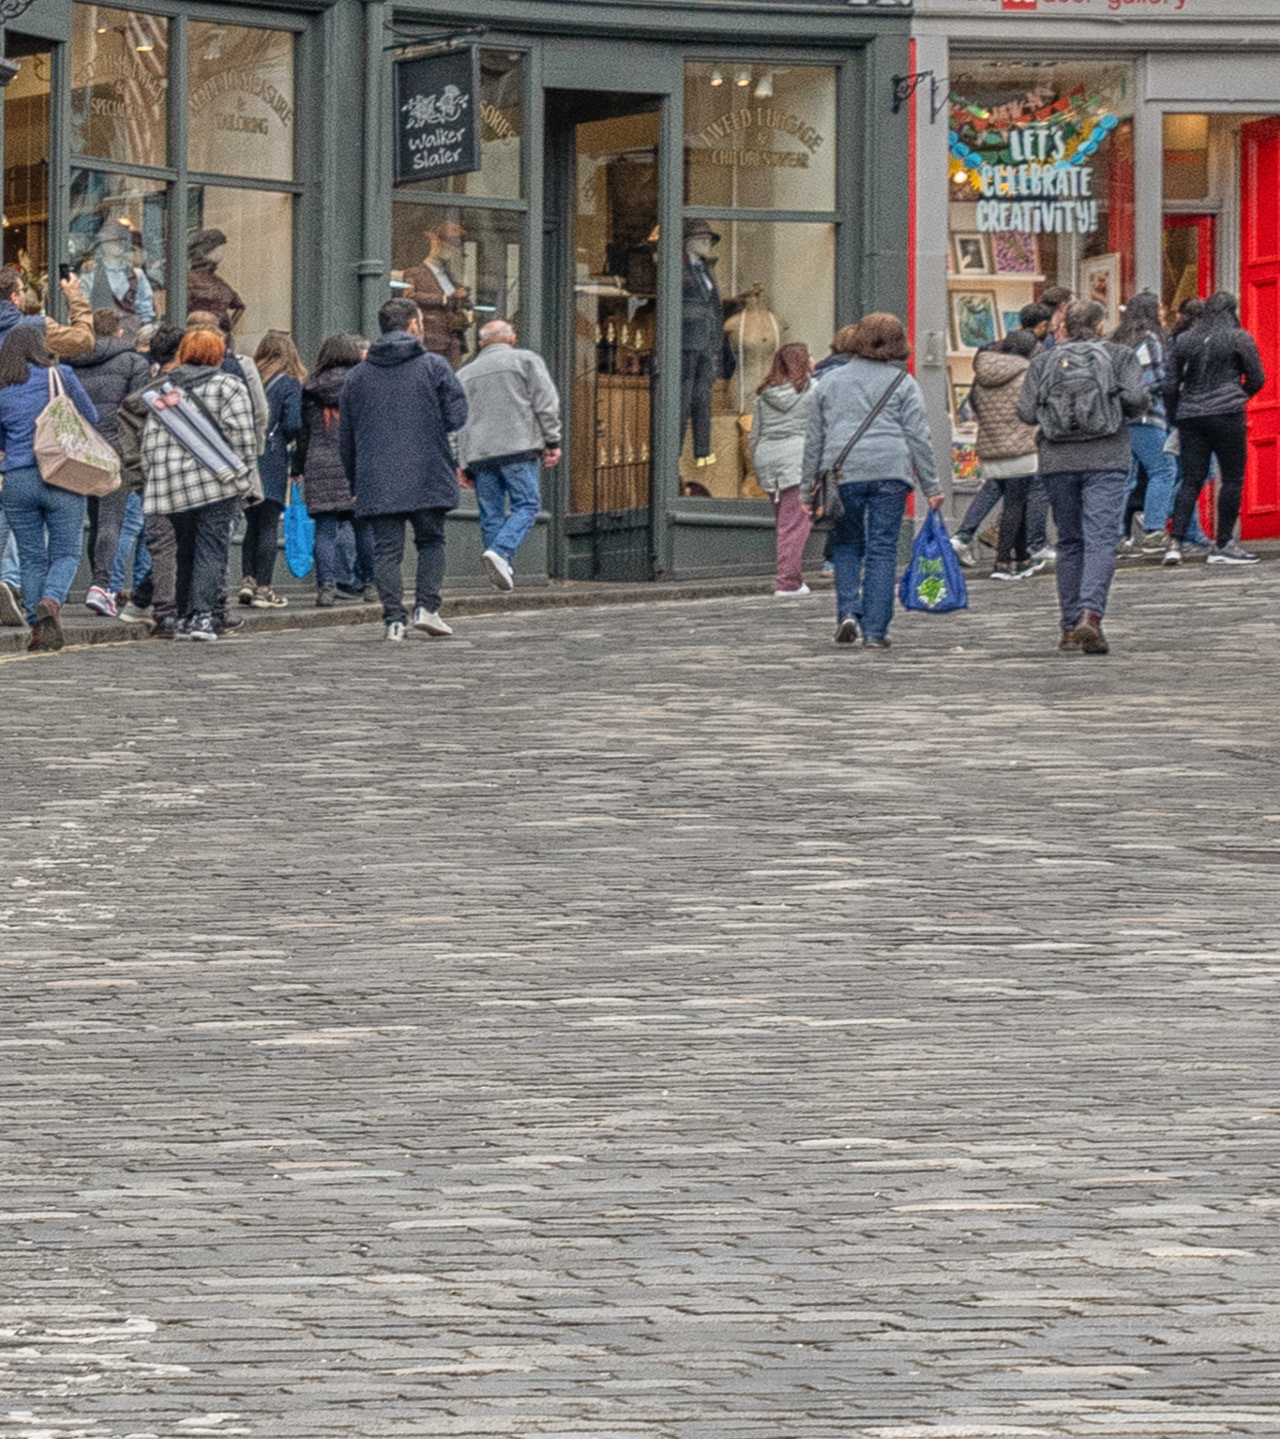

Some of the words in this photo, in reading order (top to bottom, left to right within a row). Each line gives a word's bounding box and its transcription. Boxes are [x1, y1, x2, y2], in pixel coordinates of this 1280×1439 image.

[413, 148, 462, 170] Slater
[1009, 125, 1067, 162] LET'S
[980, 164, 1095, 198] CELEBRATE
[975, 199, 1099, 234] CREATIVITY!
